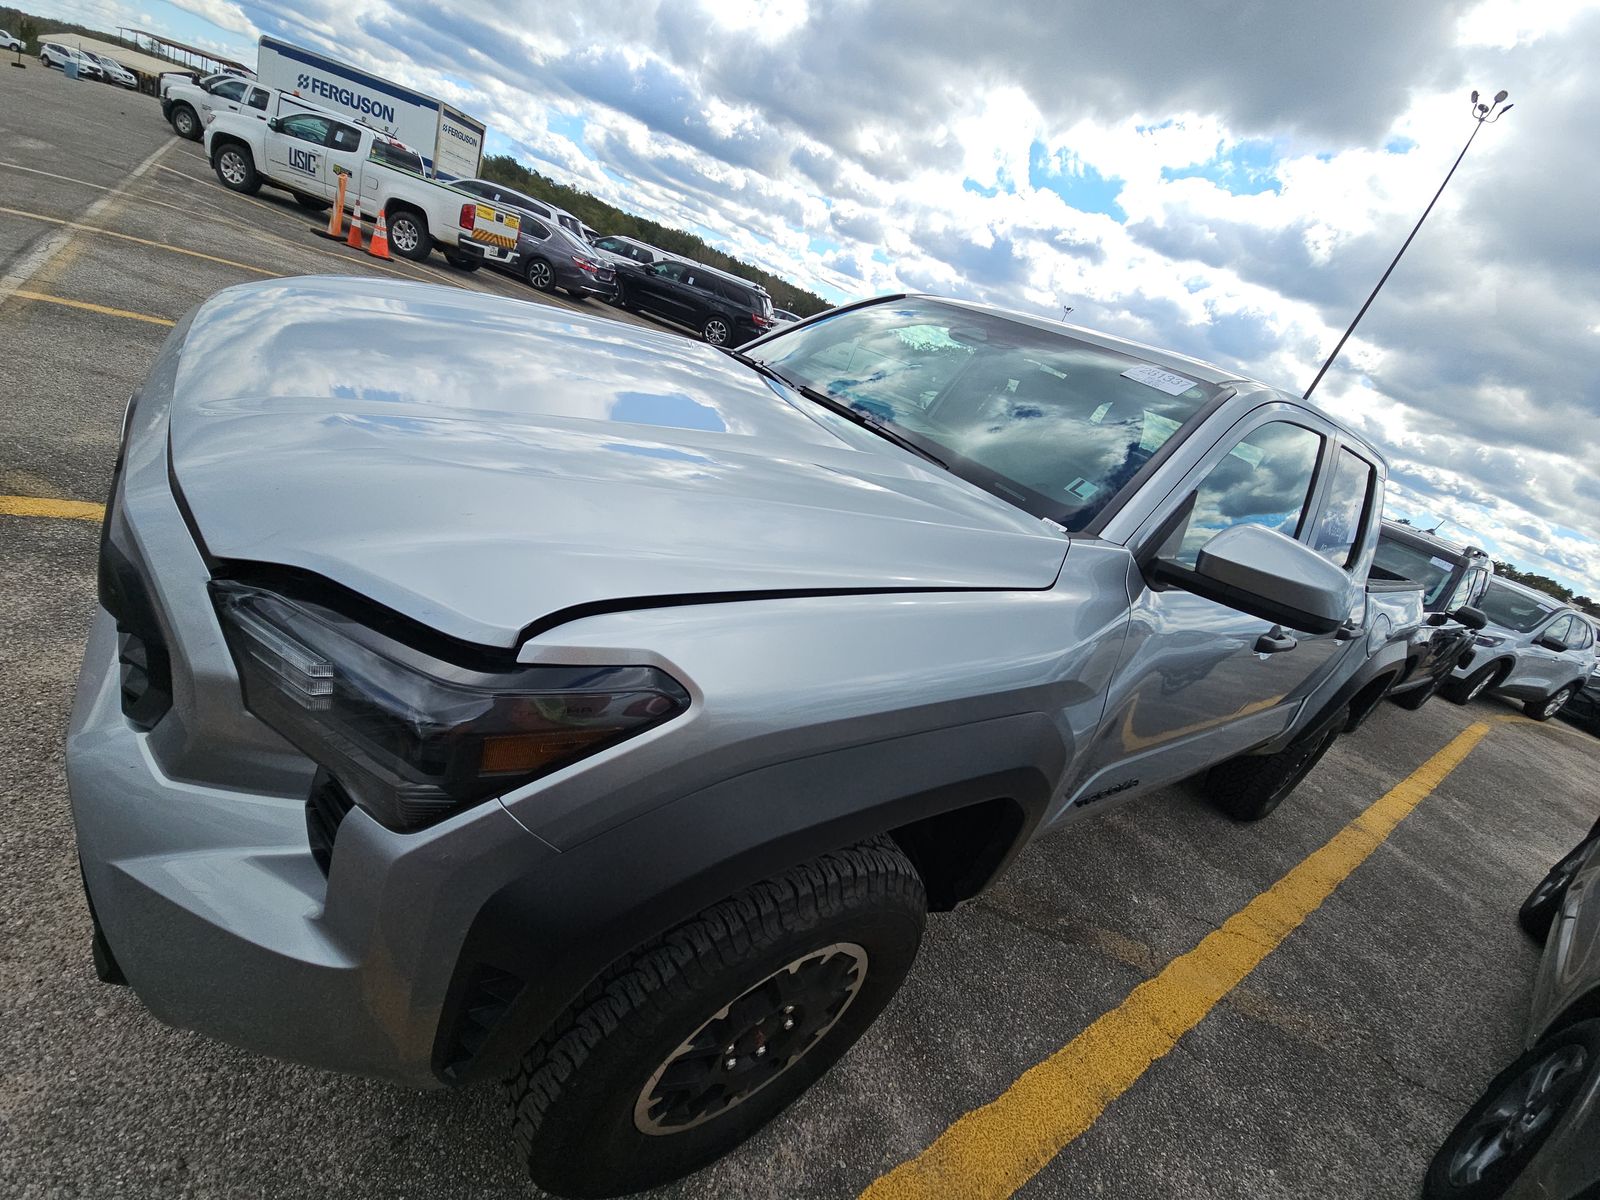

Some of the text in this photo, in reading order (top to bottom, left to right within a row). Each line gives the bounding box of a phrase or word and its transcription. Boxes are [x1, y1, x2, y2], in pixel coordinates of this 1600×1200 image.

[312, 77, 394, 123] FERGUSON
[447, 126, 478, 148] FERGUSON
[289, 147, 316, 174] USIC
